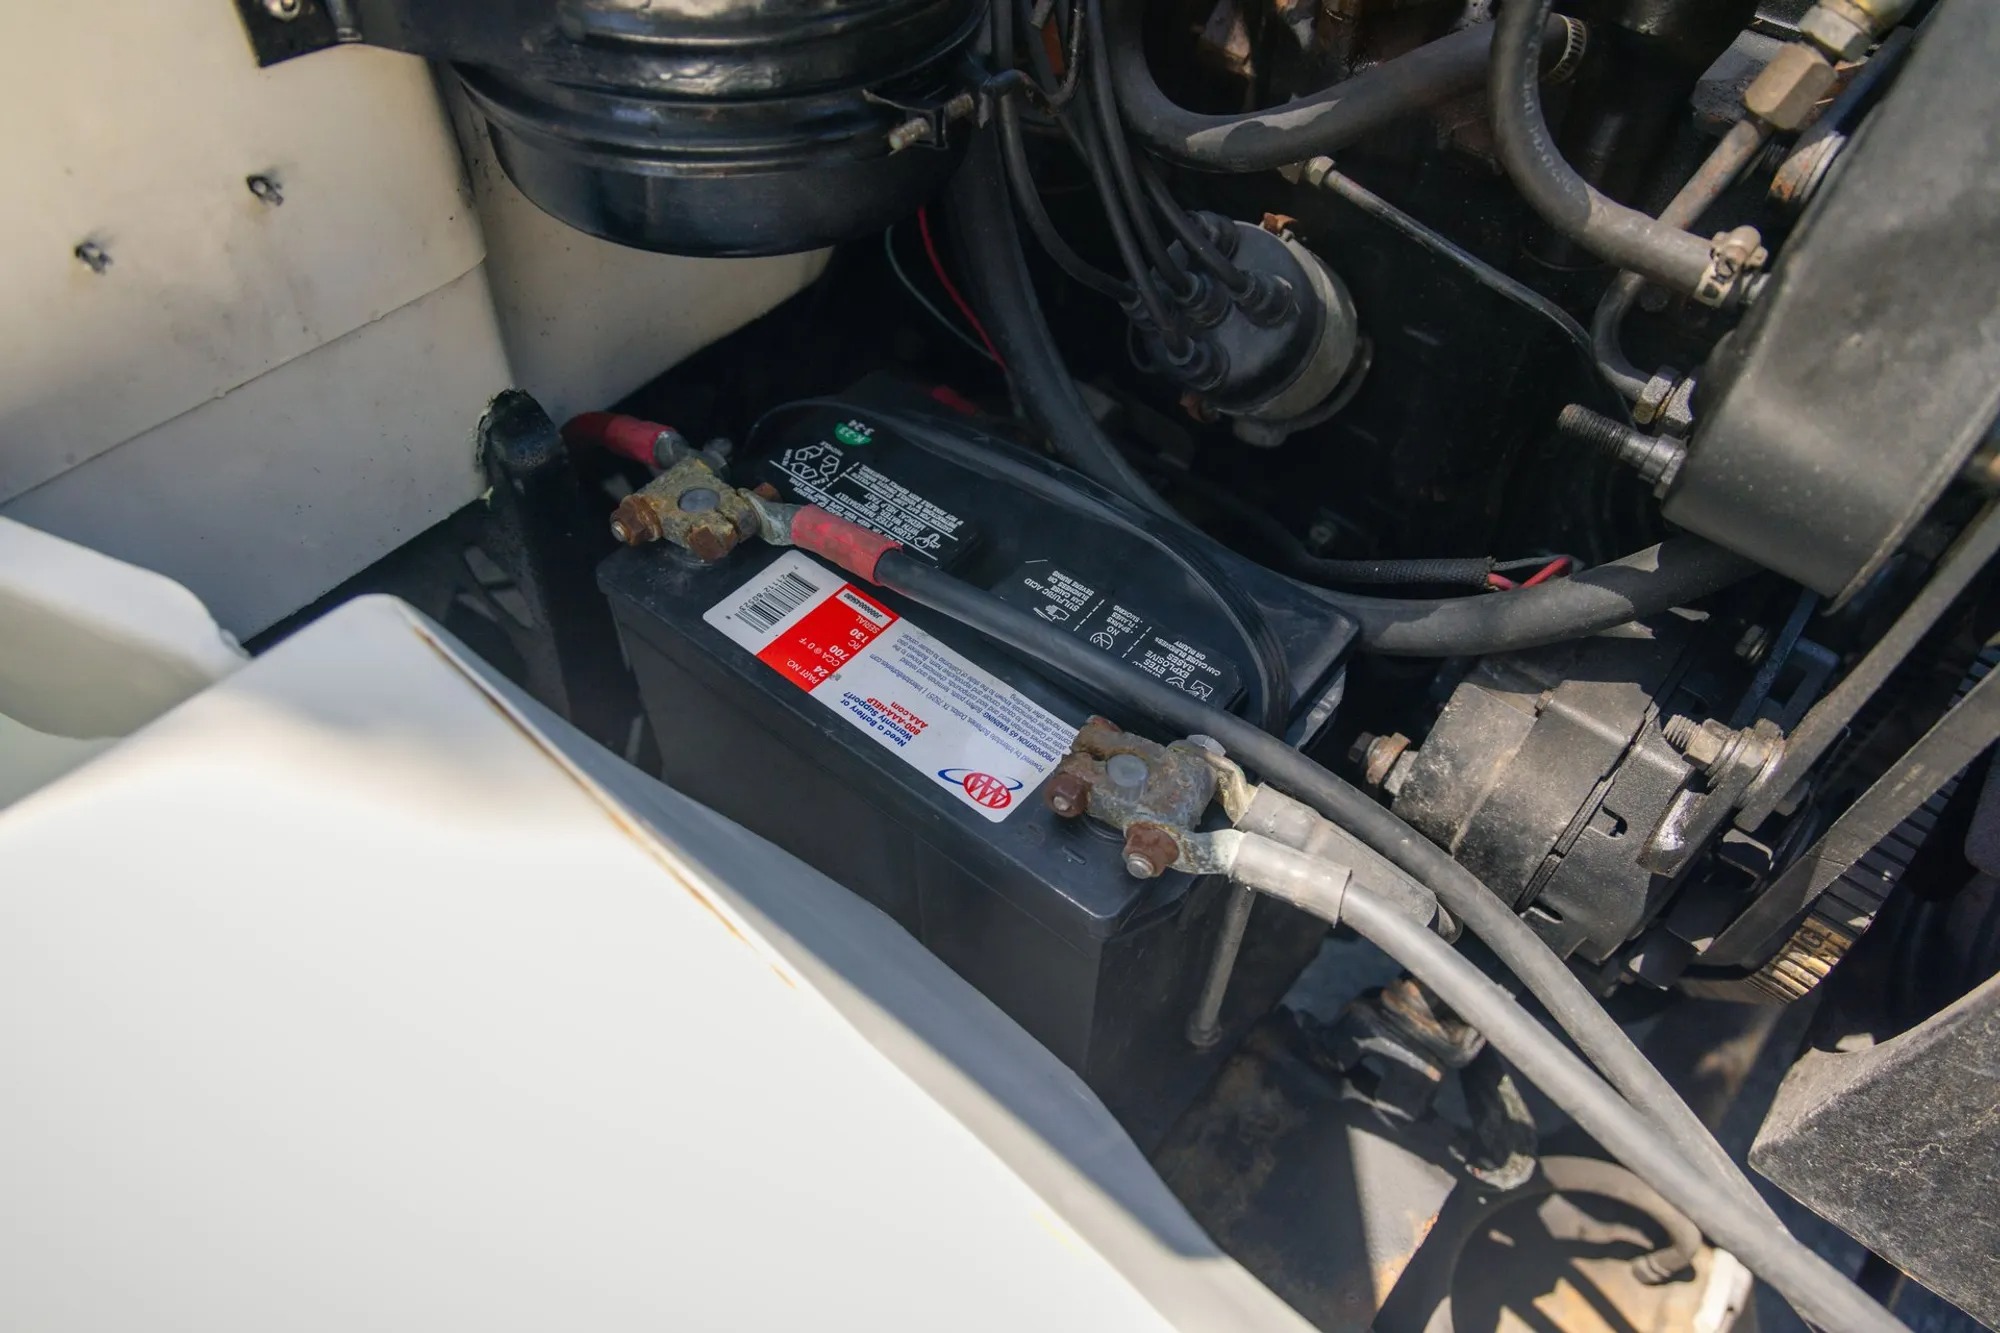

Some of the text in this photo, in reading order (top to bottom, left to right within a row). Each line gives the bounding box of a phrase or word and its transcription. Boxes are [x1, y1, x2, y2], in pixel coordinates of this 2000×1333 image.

[862, 491, 926, 530] MEDICAL HELP FAST
[863, 500, 879, 511] GET
[833, 490, 914, 540] FLUSH EYES IMMEDIATELY
[900, 522, 920, 535] WITH
[761, 573, 788, 593] 21112
[738, 591, 764, 611] 80523
[1023, 577, 1080, 612] SULFURIC ACID
[1050, 585, 1085, 605] CAN CAUSE
[852, 614, 880, 633] SERIAL
[1105, 625, 1120, 636] NO
[846, 638, 862, 649] RC
[848, 627, 870, 643] 130
[806, 641, 816, 649] 0
[811, 646, 823, 654] @
[827, 644, 850, 660] 700
[1173, 639, 1206, 660] OR INJURY
[819, 651, 841, 667] CCA
[898, 656, 918, 671] related
[1143, 649, 1189, 679] EXPLOSIVE
[1153, 636, 1221, 676] CAN CAUSE BLINDNESS
[1165, 652, 1195, 672] GASES
[783, 657, 820, 684] PART NO.
[812, 664, 829, 677] 24
[867, 652, 924, 691] InterstateBatteries.com
[915, 668, 928, 677] and
[1142, 657, 1166, 674] EYES
[925, 674, 951, 692] terminals
[970, 686, 983, 696] and
[839, 698, 851, 707] or
[924, 691, 944, 705] 75251
[962, 698, 984, 713] Battery
[974, 698, 989, 708] lead
[842, 689, 914, 741] Warranty Support?
[847, 704, 879, 727] Battery
[865, 696, 922, 735] 800-AAA-HELP
[888, 701, 928, 729] AAA.com
[986, 706, 1000, 716] and
[996, 713, 1011, 723] lead
[979, 710, 1011, 732] WARNING:
[1008, 720, 1032, 737] contain
[1019, 719, 1048, 738] California
[882, 729, 907, 747] Need
[1007, 729, 1019, 738] 65
[987, 733, 1016, 753] Interstate
[1016, 735, 1056, 762] PROPOSITION
[1011, 749, 1023, 758] by
[1019, 754, 1045, 772] Powered
[964, 773, 1011, 809] AAA
